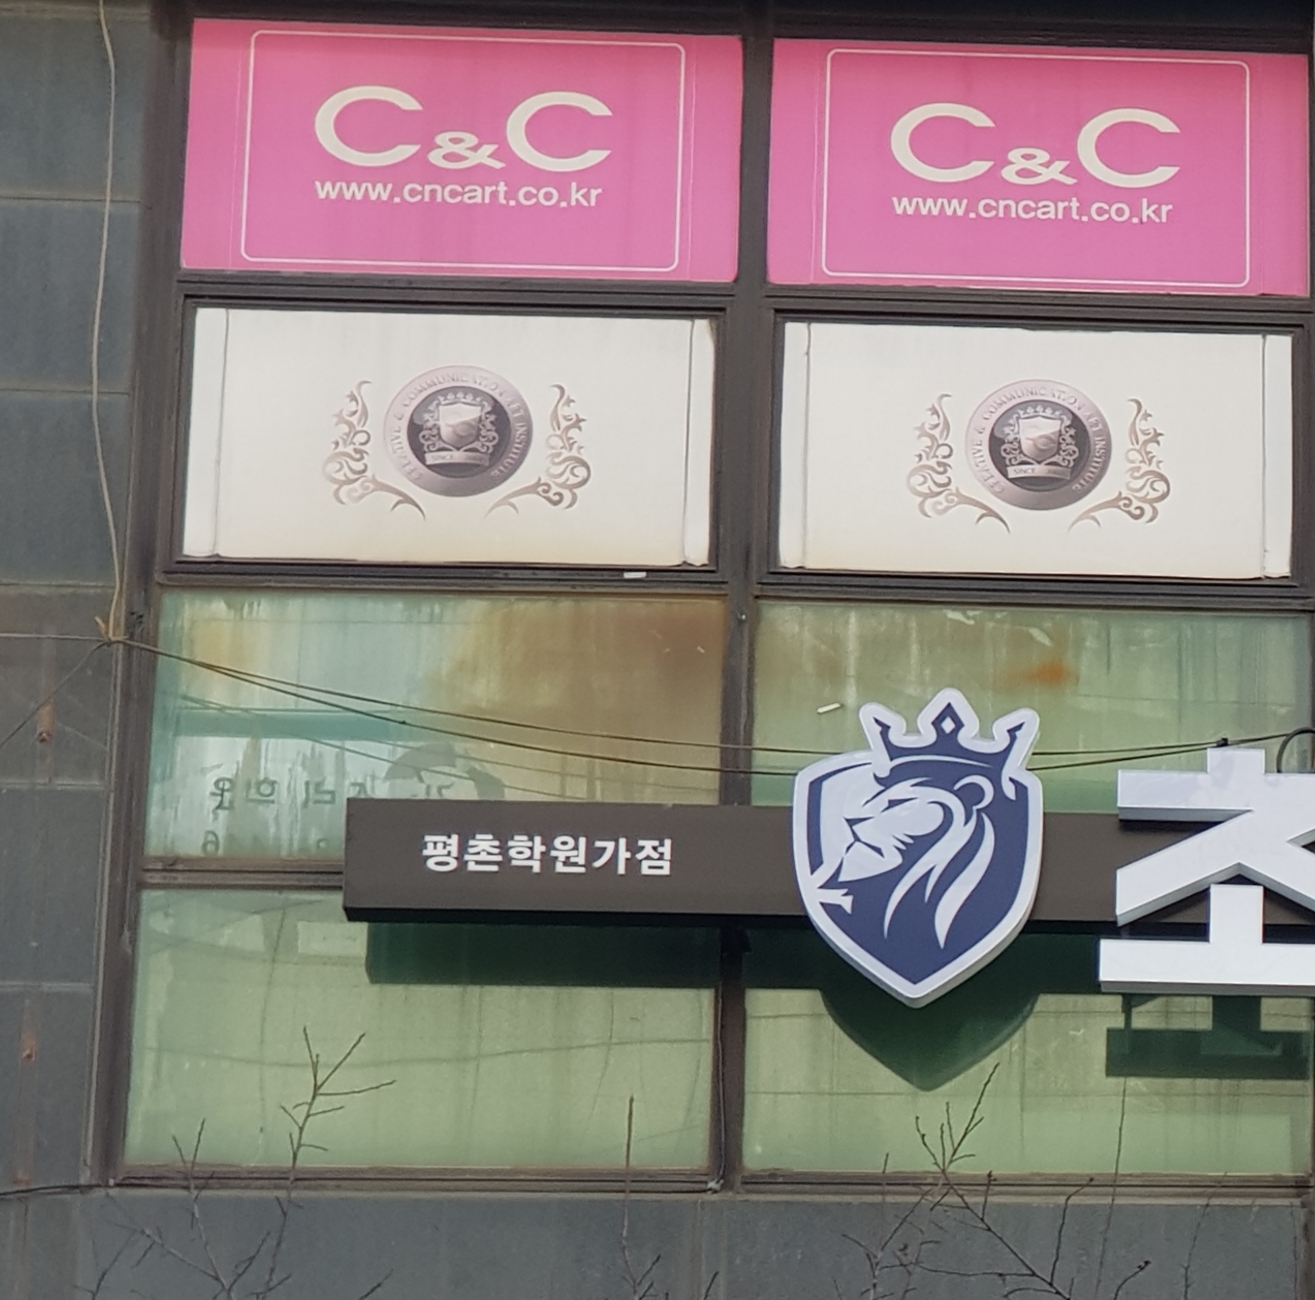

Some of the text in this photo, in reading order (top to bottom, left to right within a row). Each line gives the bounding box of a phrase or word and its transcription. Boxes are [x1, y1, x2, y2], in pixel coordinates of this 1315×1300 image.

[314, 85, 611, 172] C&C
[890, 102, 1180, 186] C&C
[314, 180, 602, 208] www.cncart.co.kr
[892, 194, 1172, 224] www.cncart.co.kr
[421, 832, 673, 877] 평촌학원가점
